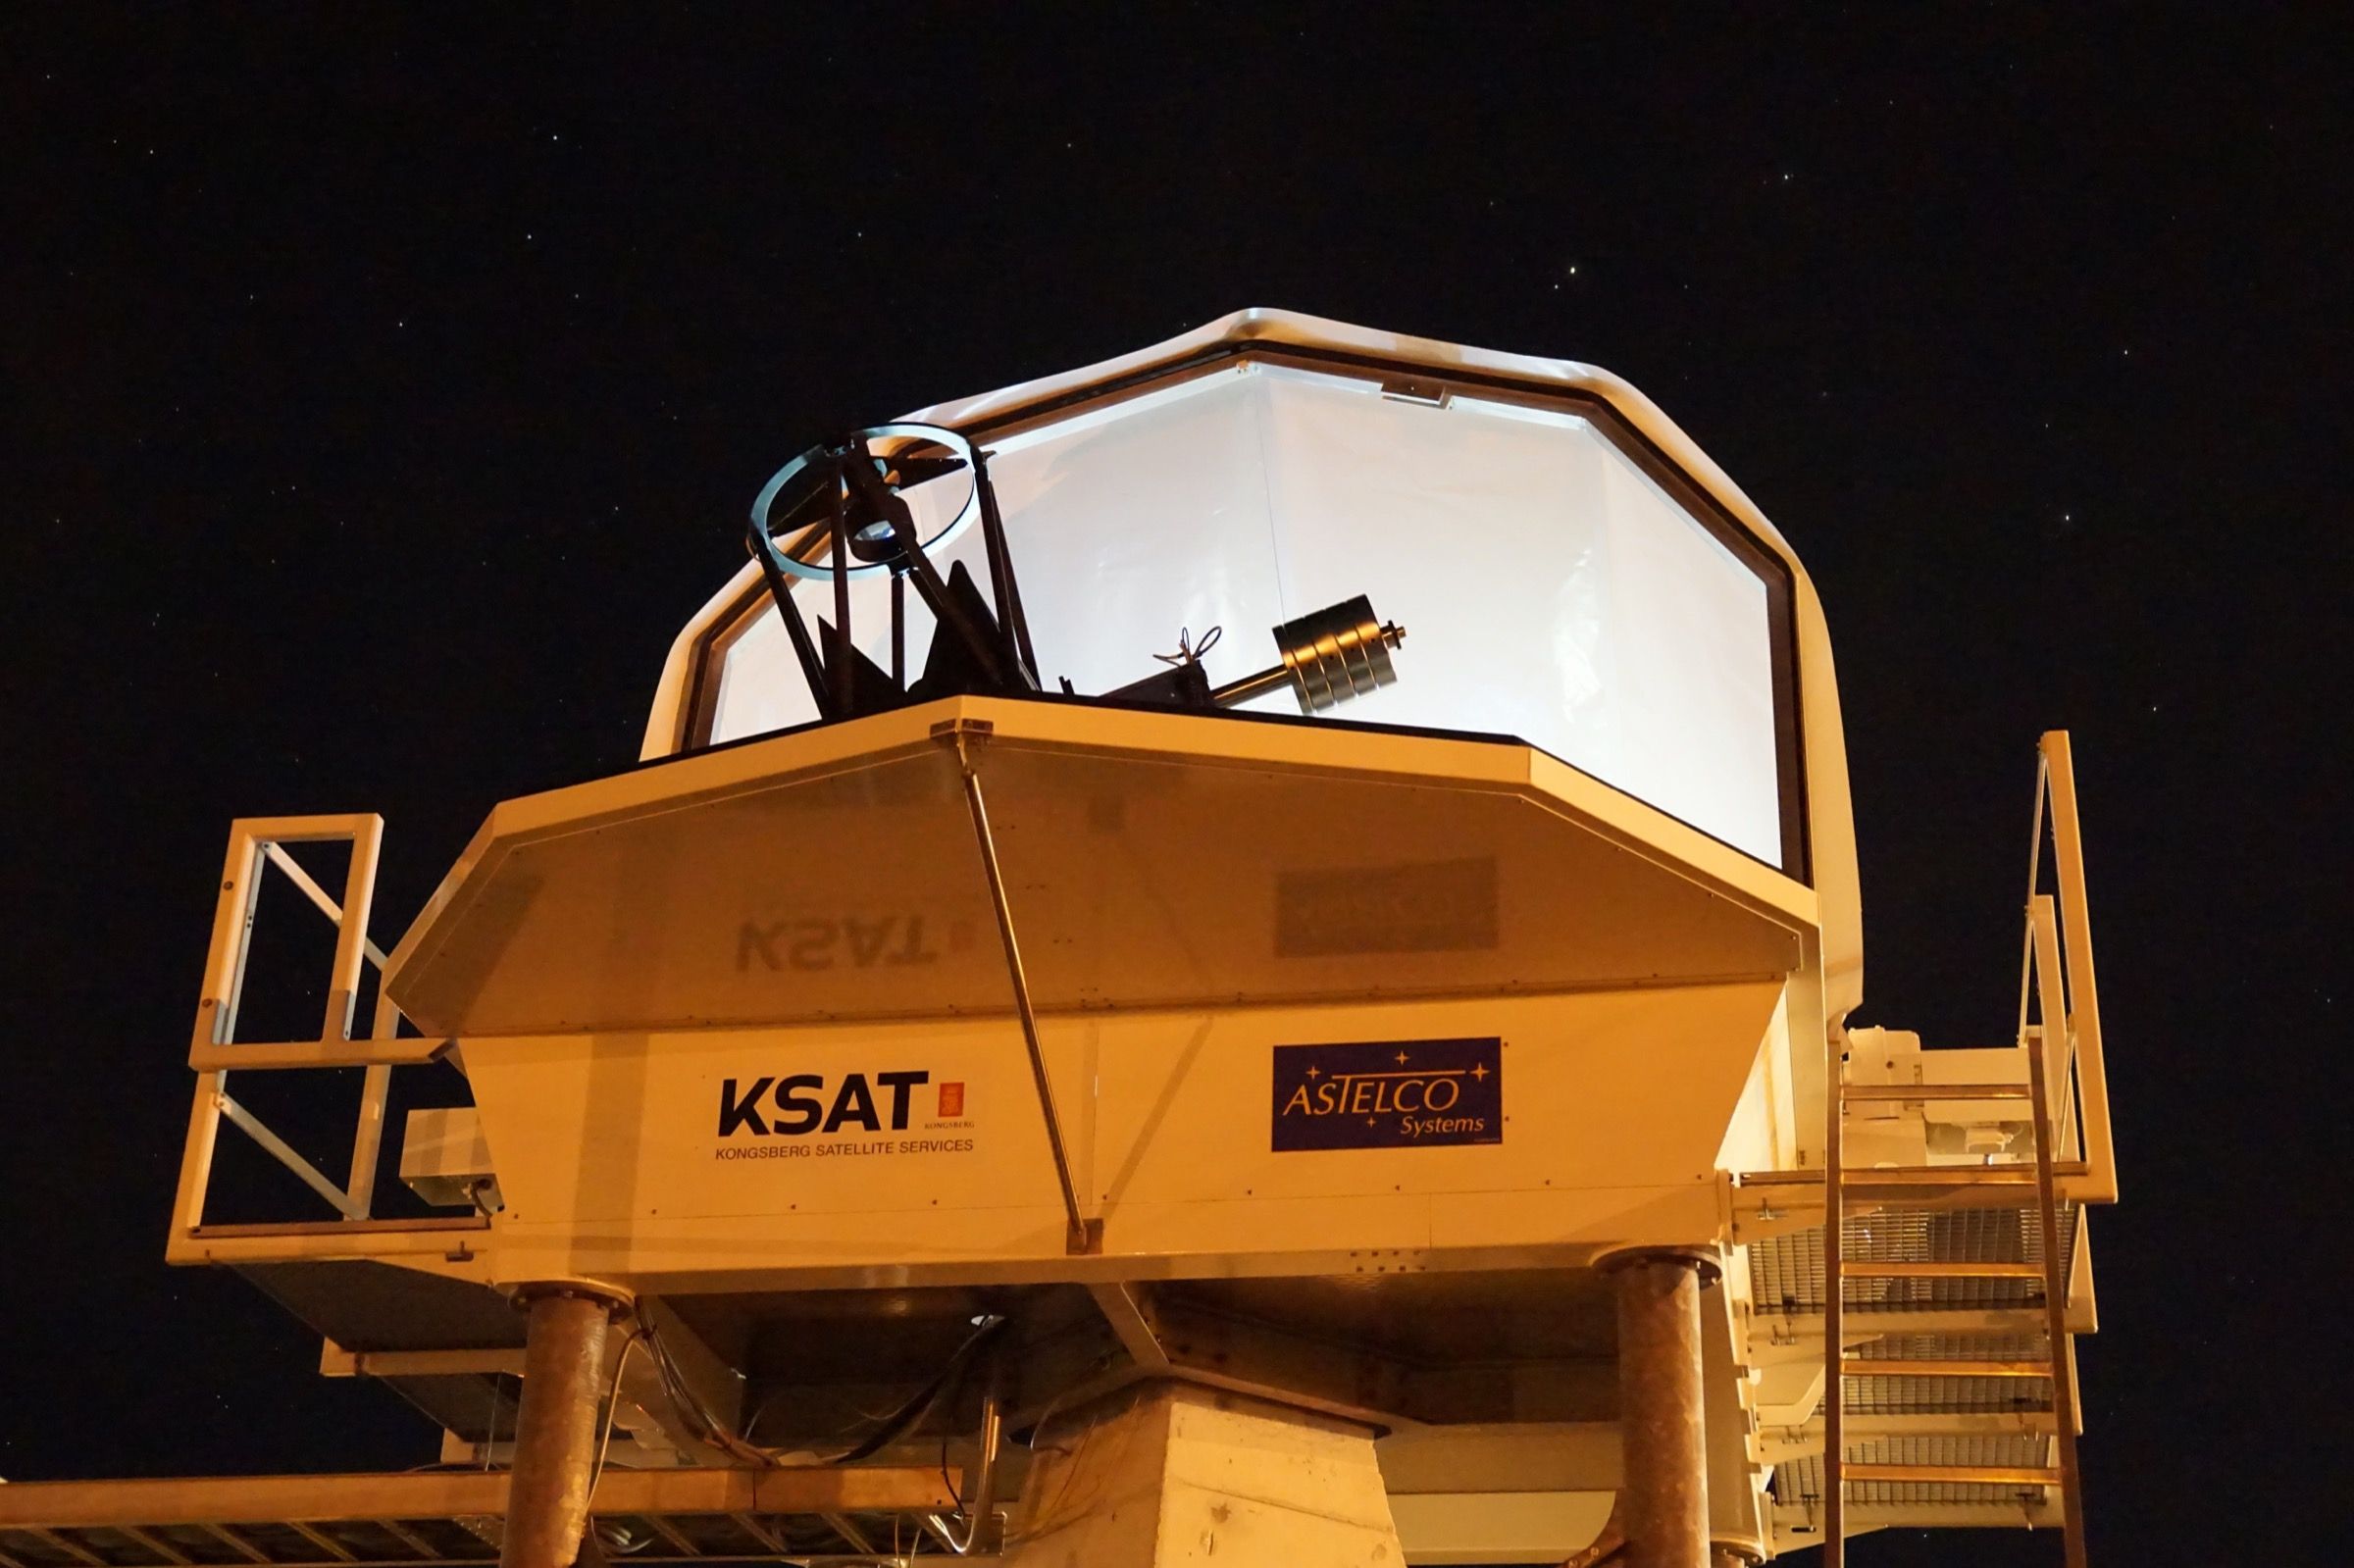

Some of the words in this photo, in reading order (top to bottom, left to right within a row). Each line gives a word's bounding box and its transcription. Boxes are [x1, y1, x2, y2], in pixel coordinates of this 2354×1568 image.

[718, 1071, 929, 1138] KSAT
[1282, 1074, 1460, 1116] ASTELCO
[924, 1121, 975, 1130] KONGSBERG
[1401, 1115, 1485, 1138] Systems
[715, 1145, 810, 1160] KONGSBERG
[815, 1141, 894, 1157] SATELLITE
[899, 1138, 974, 1154] SERVICES
